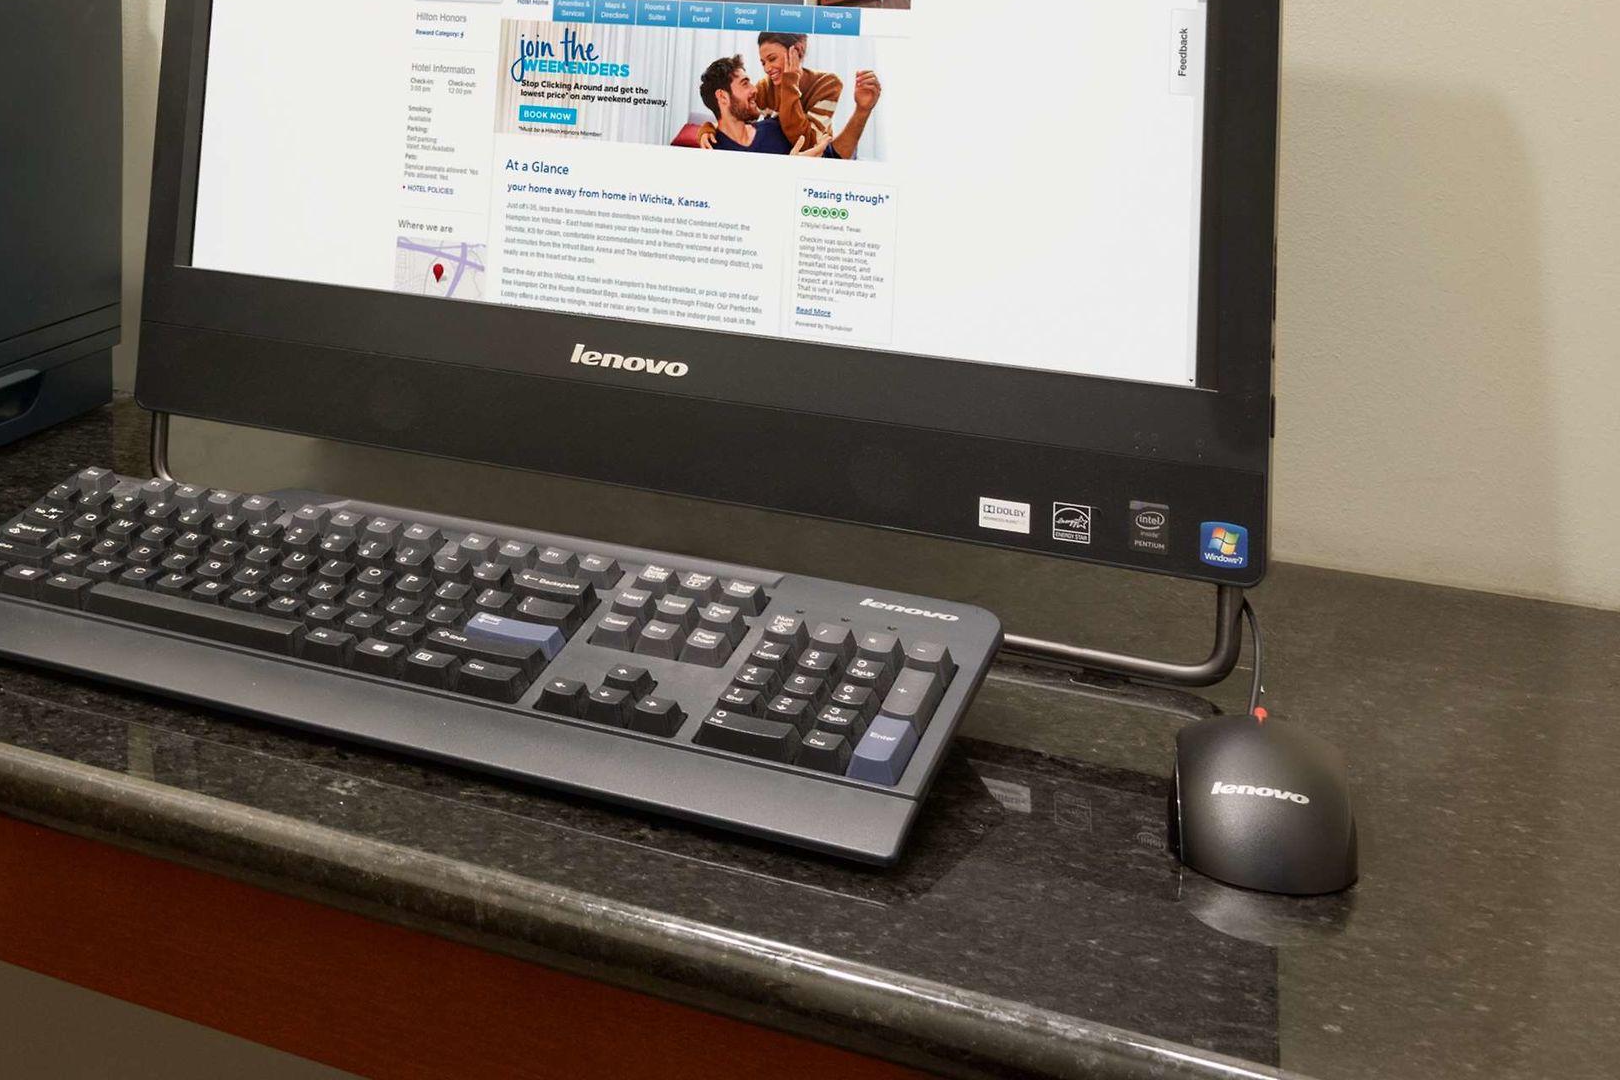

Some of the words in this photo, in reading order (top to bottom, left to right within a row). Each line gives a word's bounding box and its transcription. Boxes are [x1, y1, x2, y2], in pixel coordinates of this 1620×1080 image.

[557, 0, 585, 8] Amenities
[644, 3, 665, 11] Rooms
[734, 7, 757, 15] Special
[780, 10, 801, 18] Dining
[823, 11, 844, 20] Things
[416, 12, 438, 21] Hilton
[440, 13, 467, 22] Honors
[736, 17, 754, 25] Offers
[511, 34, 554, 82] join
[560, 27, 599, 66] the
[1178, 28, 1188, 77] Feedback
[412, 63, 431, 72] Hotel
[433, 64, 475, 74] Information
[523, 60, 630, 78] WEEKENDERS
[522, 79, 539, 88] Stop
[541, 80, 572, 91] Clicking
[574, 82, 602, 92] Around
[604, 84, 619, 93] and
[620, 86, 633, 95] get
[635, 86, 648, 94] the
[520, 90, 545, 98] lowest
[581, 95, 595, 103] any
[597, 94, 632, 103] weekend
[633, 96, 668, 107] getaway.
[524, 109, 547, 118] BOOK
[550, 112, 571, 120] NOW
[506, 159, 519, 171] At
[522, 163, 528, 172] a
[532, 161, 569, 175] Glance
[428, 186, 454, 195] POLICIES
[507, 182, 526, 192] your
[528, 183, 552, 194] home
[554, 188, 576, 198] away
[579, 187, 600, 198] from
[602, 189, 626, 200] home
[629, 194, 636, 202] in
[640, 193, 675, 206] Wichita,
[678, 197, 710, 208] Kansas.
[398, 219, 425, 230] Where
[426, 224, 438, 232] we
[837, 238, 853, 247] quick
[799, 245, 815, 253] using
[848, 248, 863, 256] Staff
[798, 260, 826, 269] breakfast
[798, 269, 833, 279] atmosphere
[873, 275, 884, 283] like
[796, 307, 813, 315] Read
[814, 308, 831, 317] More
[570, 343, 689, 377] lenovo
[996, 507, 1026, 517] DOLBY
[118, 520, 133, 528] W
[1140, 514, 1160, 525] intel
[151, 526, 164, 534] E
[186, 532, 198, 541] R
[222, 539, 232, 547] T
[1134, 540, 1165, 550] PENTIUM
[259, 546, 269, 554] Y
[293, 553, 305, 562] U
[1204, 552, 1238, 563] Windows
[245, 568, 259, 577] H
[319, 583, 331, 592] K
[539, 578, 580, 590] Backspace
[242, 589, 256, 597] N
[623, 592, 643, 601] Insert
[665, 599, 686, 609] Home
[711, 605, 731, 614] Page
[860, 598, 960, 621] lenovo
[650, 625, 667, 634] End
[694, 636, 715, 644] Down
[697, 631, 716, 640] Page
[763, 641, 774, 649] 7
[757, 649, 780, 659] Home
[809, 651, 820, 659] 8
[469, 663, 484, 671] Ctrl
[857, 660, 868, 668] 9
[747, 667, 758, 675] 4
[851, 668, 875, 678] PgUp
[843, 685, 855, 693] 6
[726, 694, 744, 702] End
[830, 707, 841, 715] 3
[823, 714, 848, 723] PgDn
[870, 731, 897, 742] Enter
[809, 738, 825, 747] Del
[1211, 781, 1310, 805] lenovo
